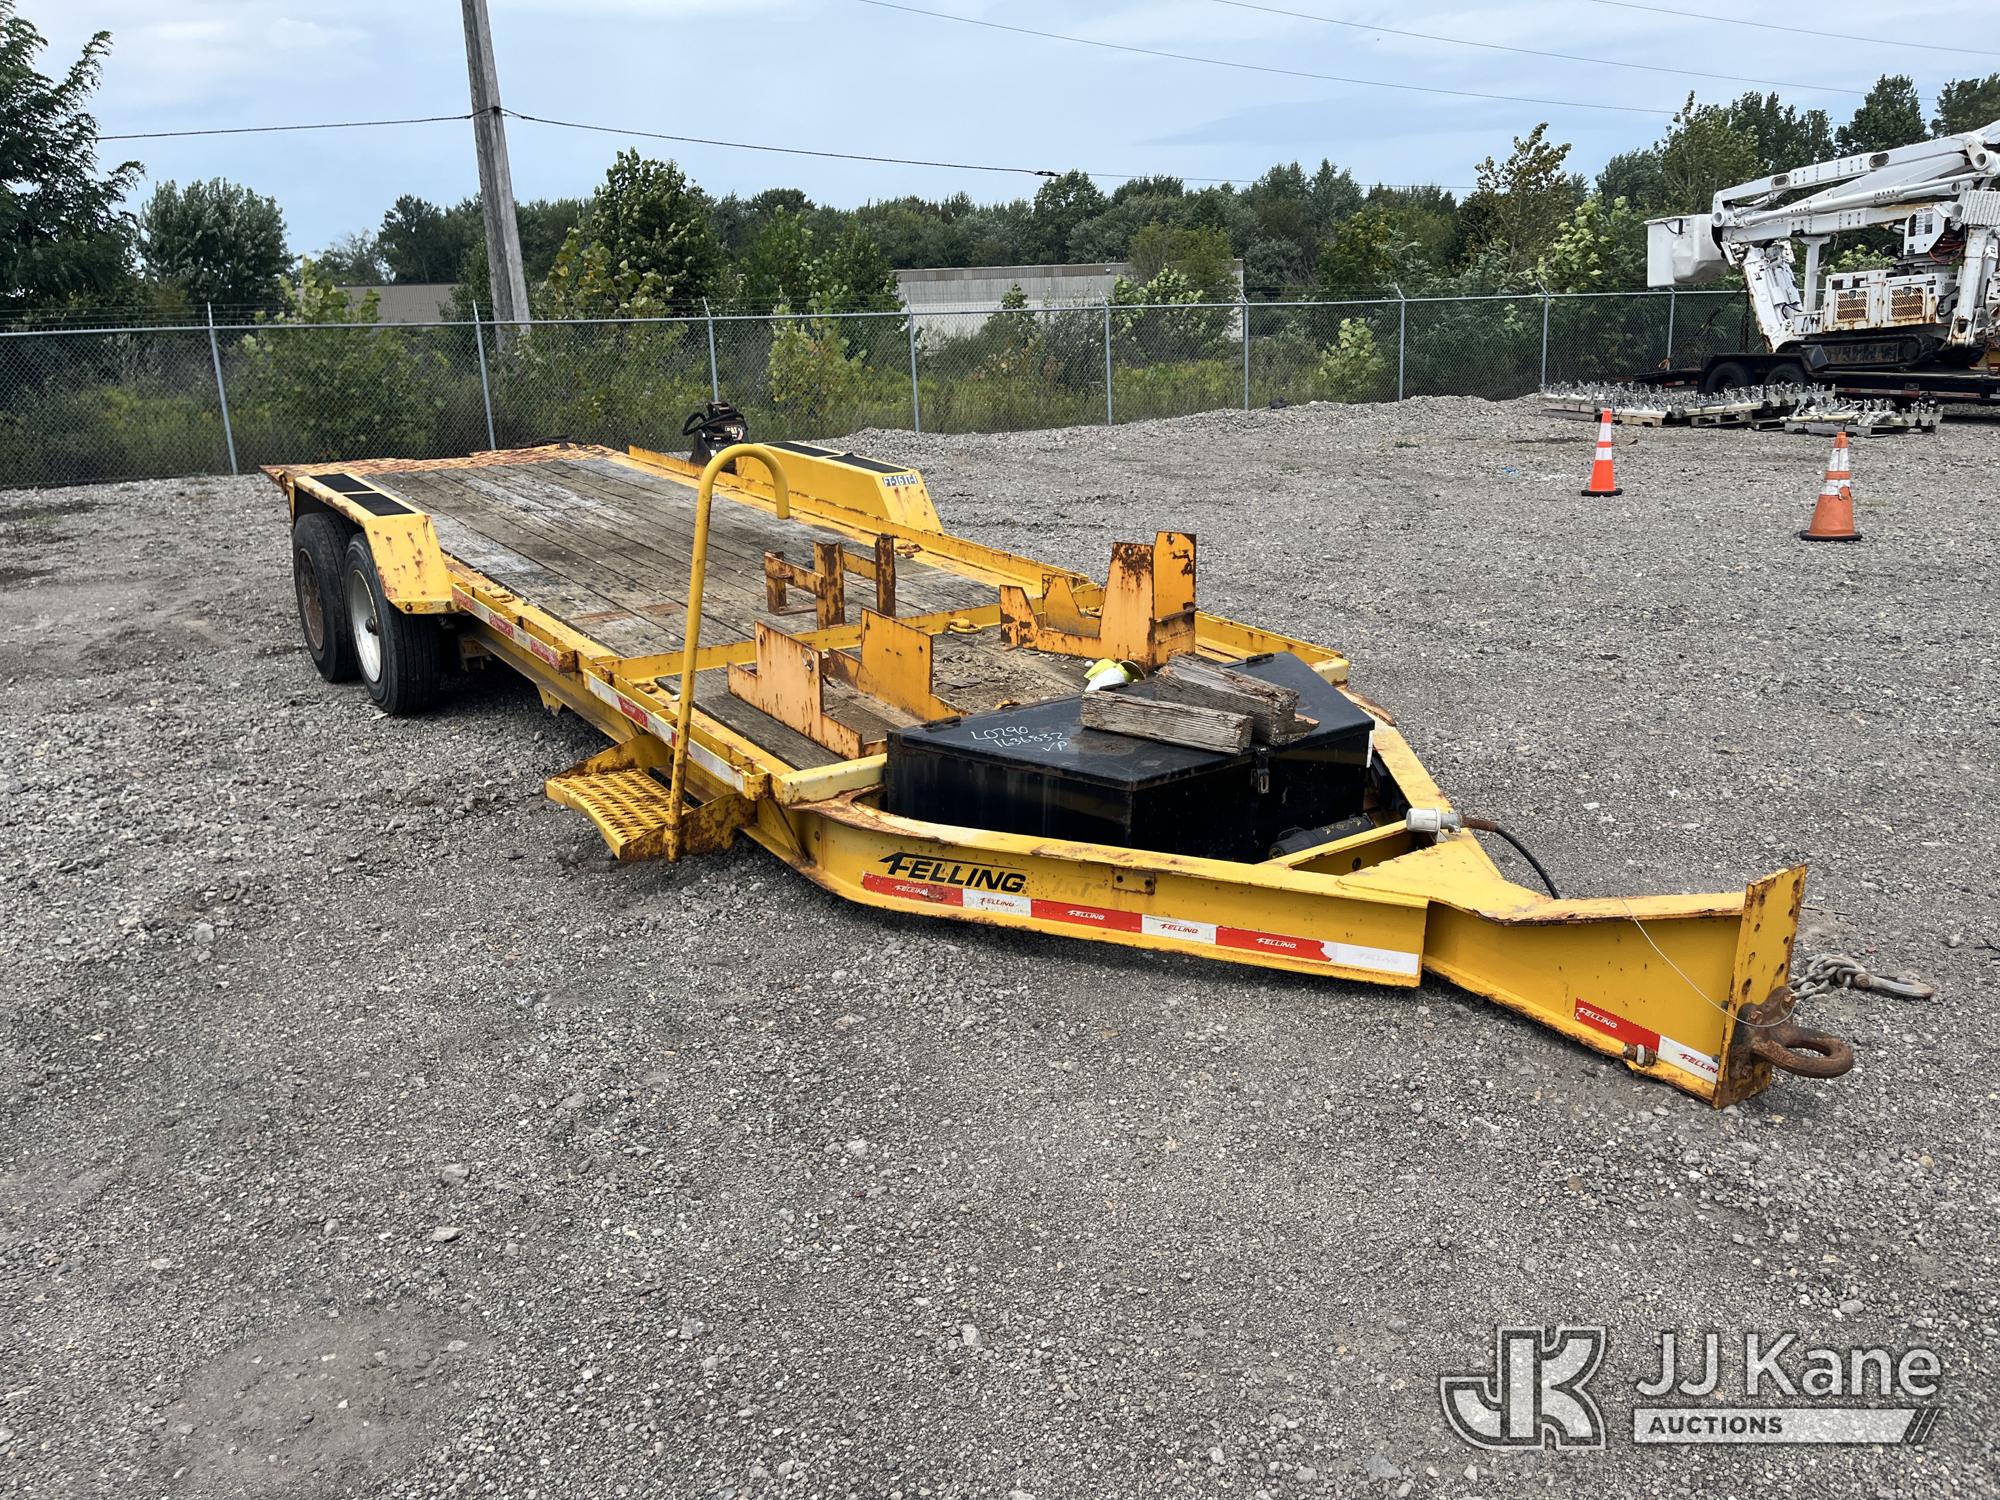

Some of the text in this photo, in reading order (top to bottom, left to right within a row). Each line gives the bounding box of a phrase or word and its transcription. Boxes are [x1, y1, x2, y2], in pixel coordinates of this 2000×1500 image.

[878, 852, 1026, 893] FELLING
[1067, 909, 1105, 920] FELLING
[1160, 923, 1199, 935] FELLING
[1256, 937, 1297, 950] FELLING
[1577, 1007, 1617, 1028] FELLING
[1679, 1053, 1718, 1075] FELLIN
